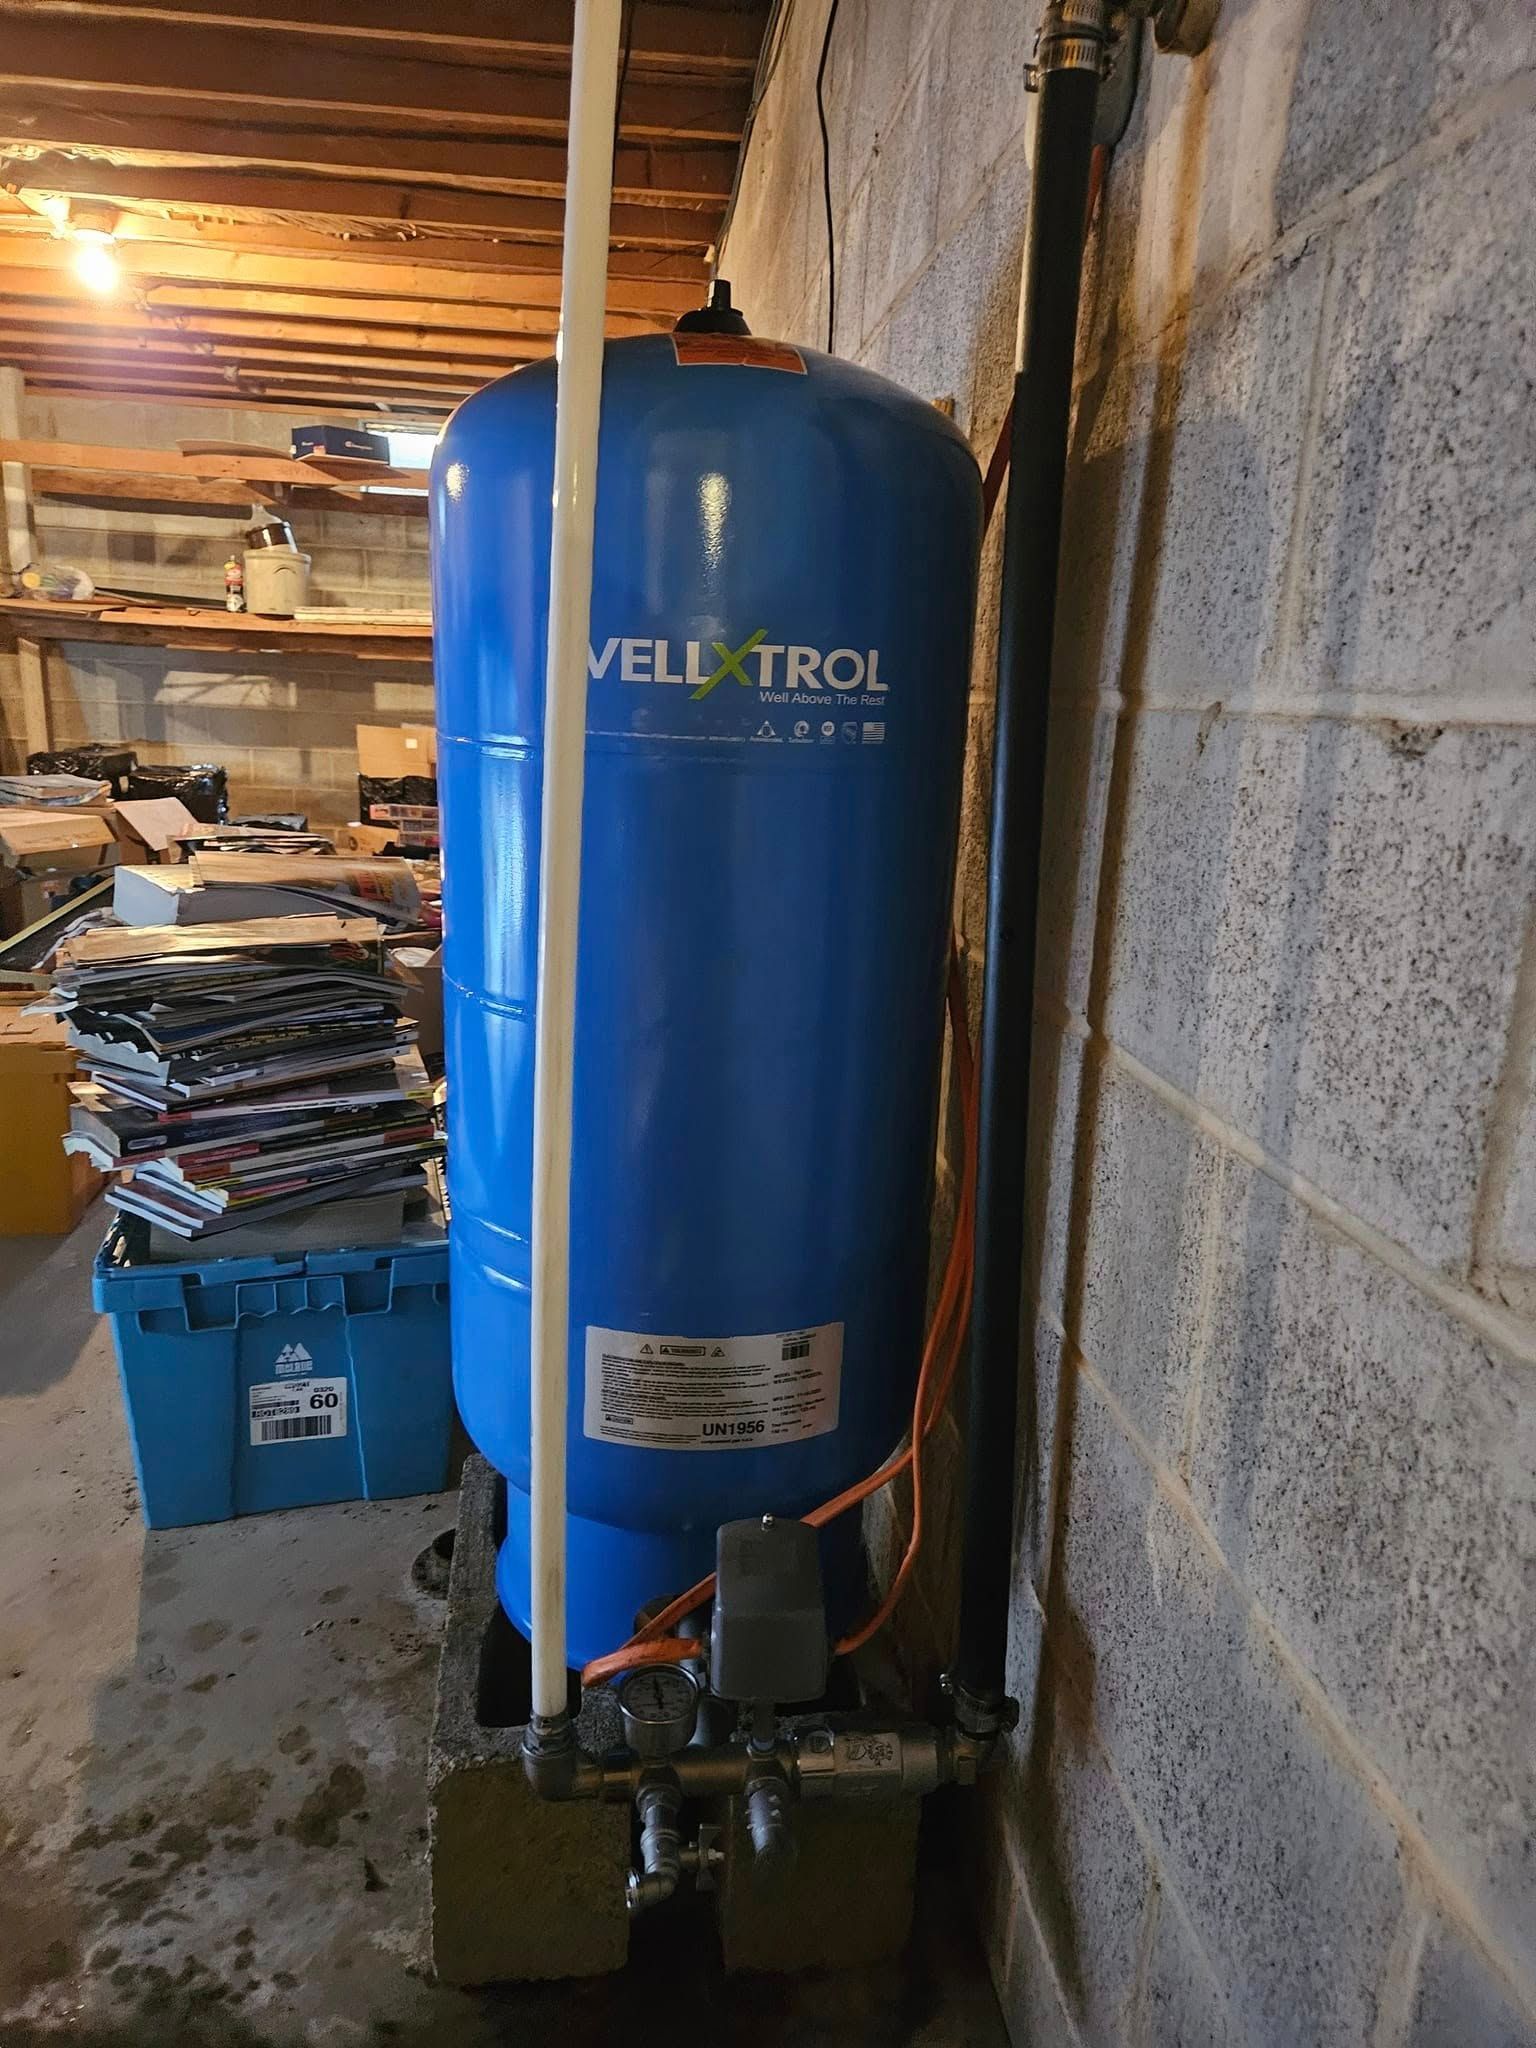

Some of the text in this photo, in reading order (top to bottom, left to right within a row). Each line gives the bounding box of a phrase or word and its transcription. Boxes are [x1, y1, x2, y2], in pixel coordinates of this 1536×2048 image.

[760, 691, 885, 706] Well Above The Rest
[310, 1393, 338, 1409] 60
[702, 1420, 765, 1436] UN1956
